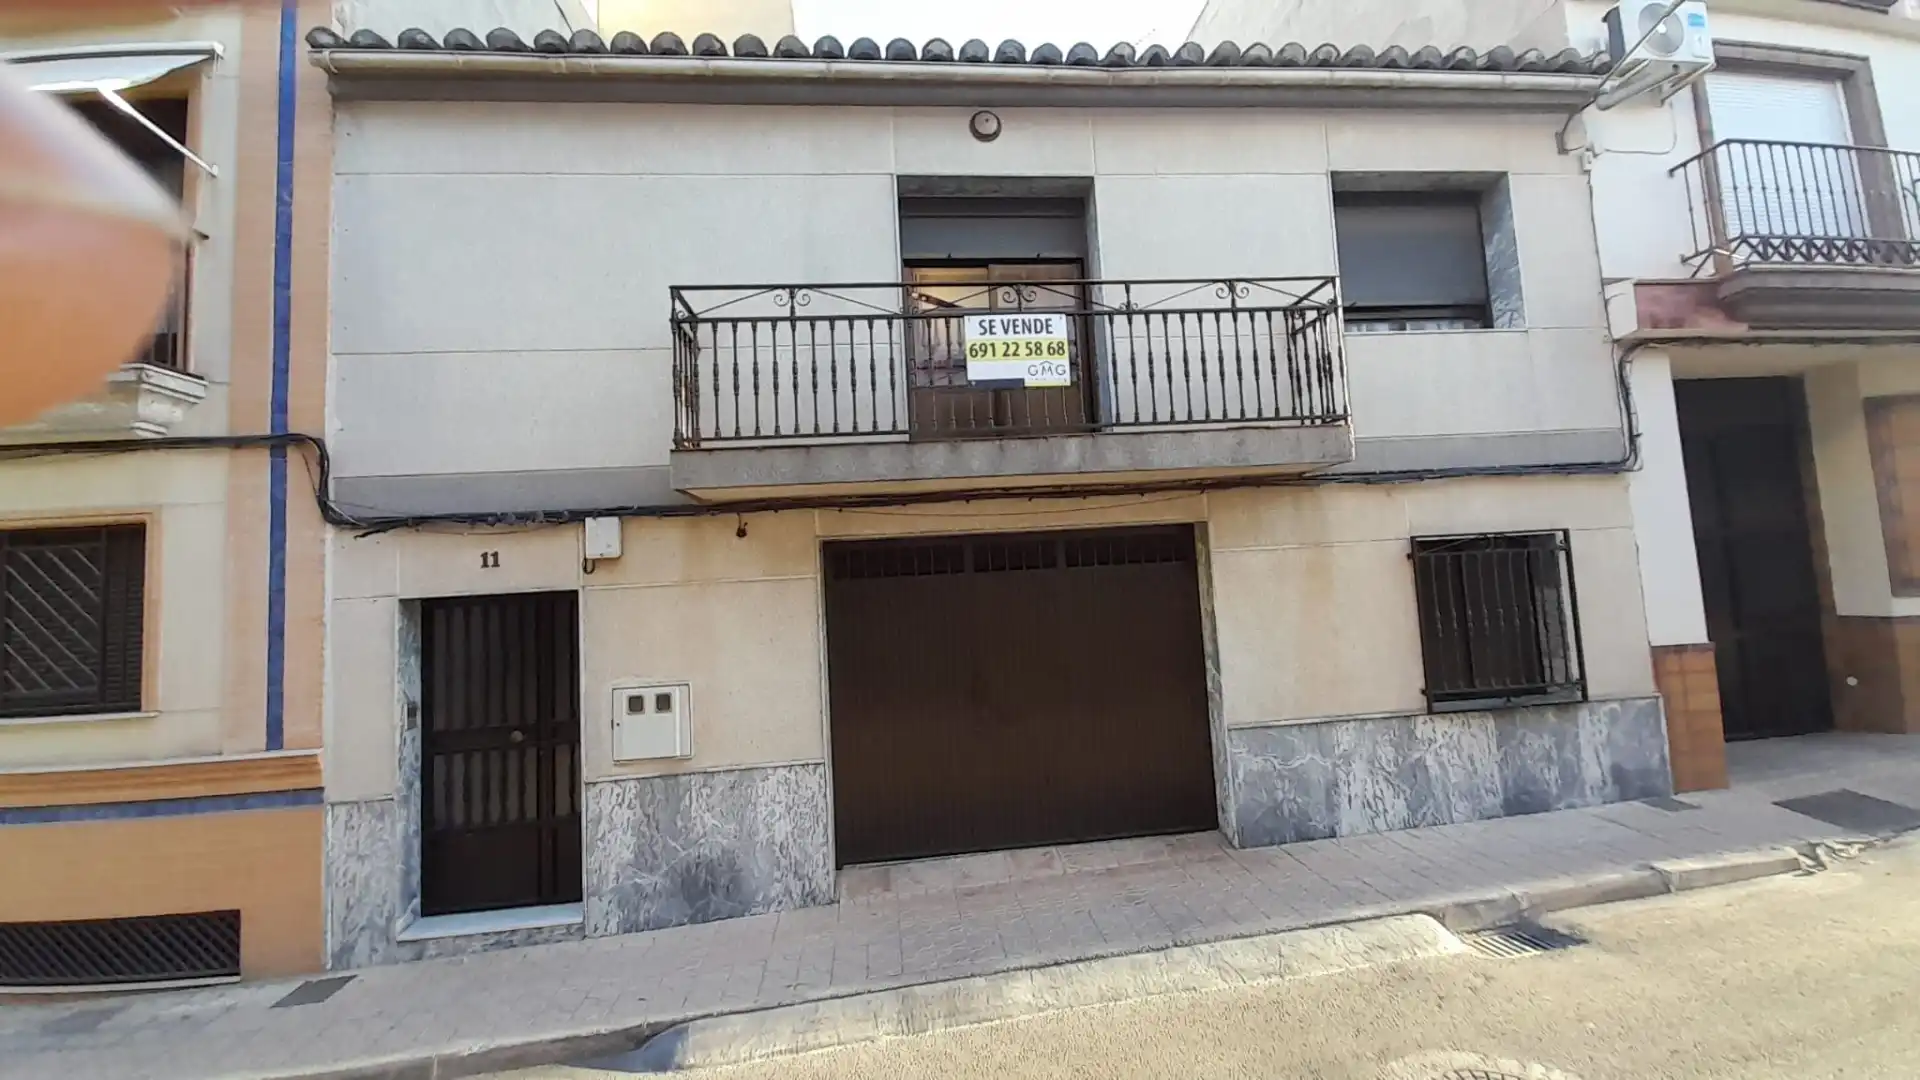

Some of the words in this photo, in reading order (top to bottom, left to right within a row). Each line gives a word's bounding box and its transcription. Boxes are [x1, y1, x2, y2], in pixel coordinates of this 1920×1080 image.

[978, 319, 996, 336] SE
[1000, 318, 1053, 335] VENDE
[969, 342, 996, 358] 691
[1002, 341, 1020, 357] 22
[1025, 341, 1043, 357] 58
[1047, 340, 1065, 356] 68
[480, 551, 500, 568] 11
